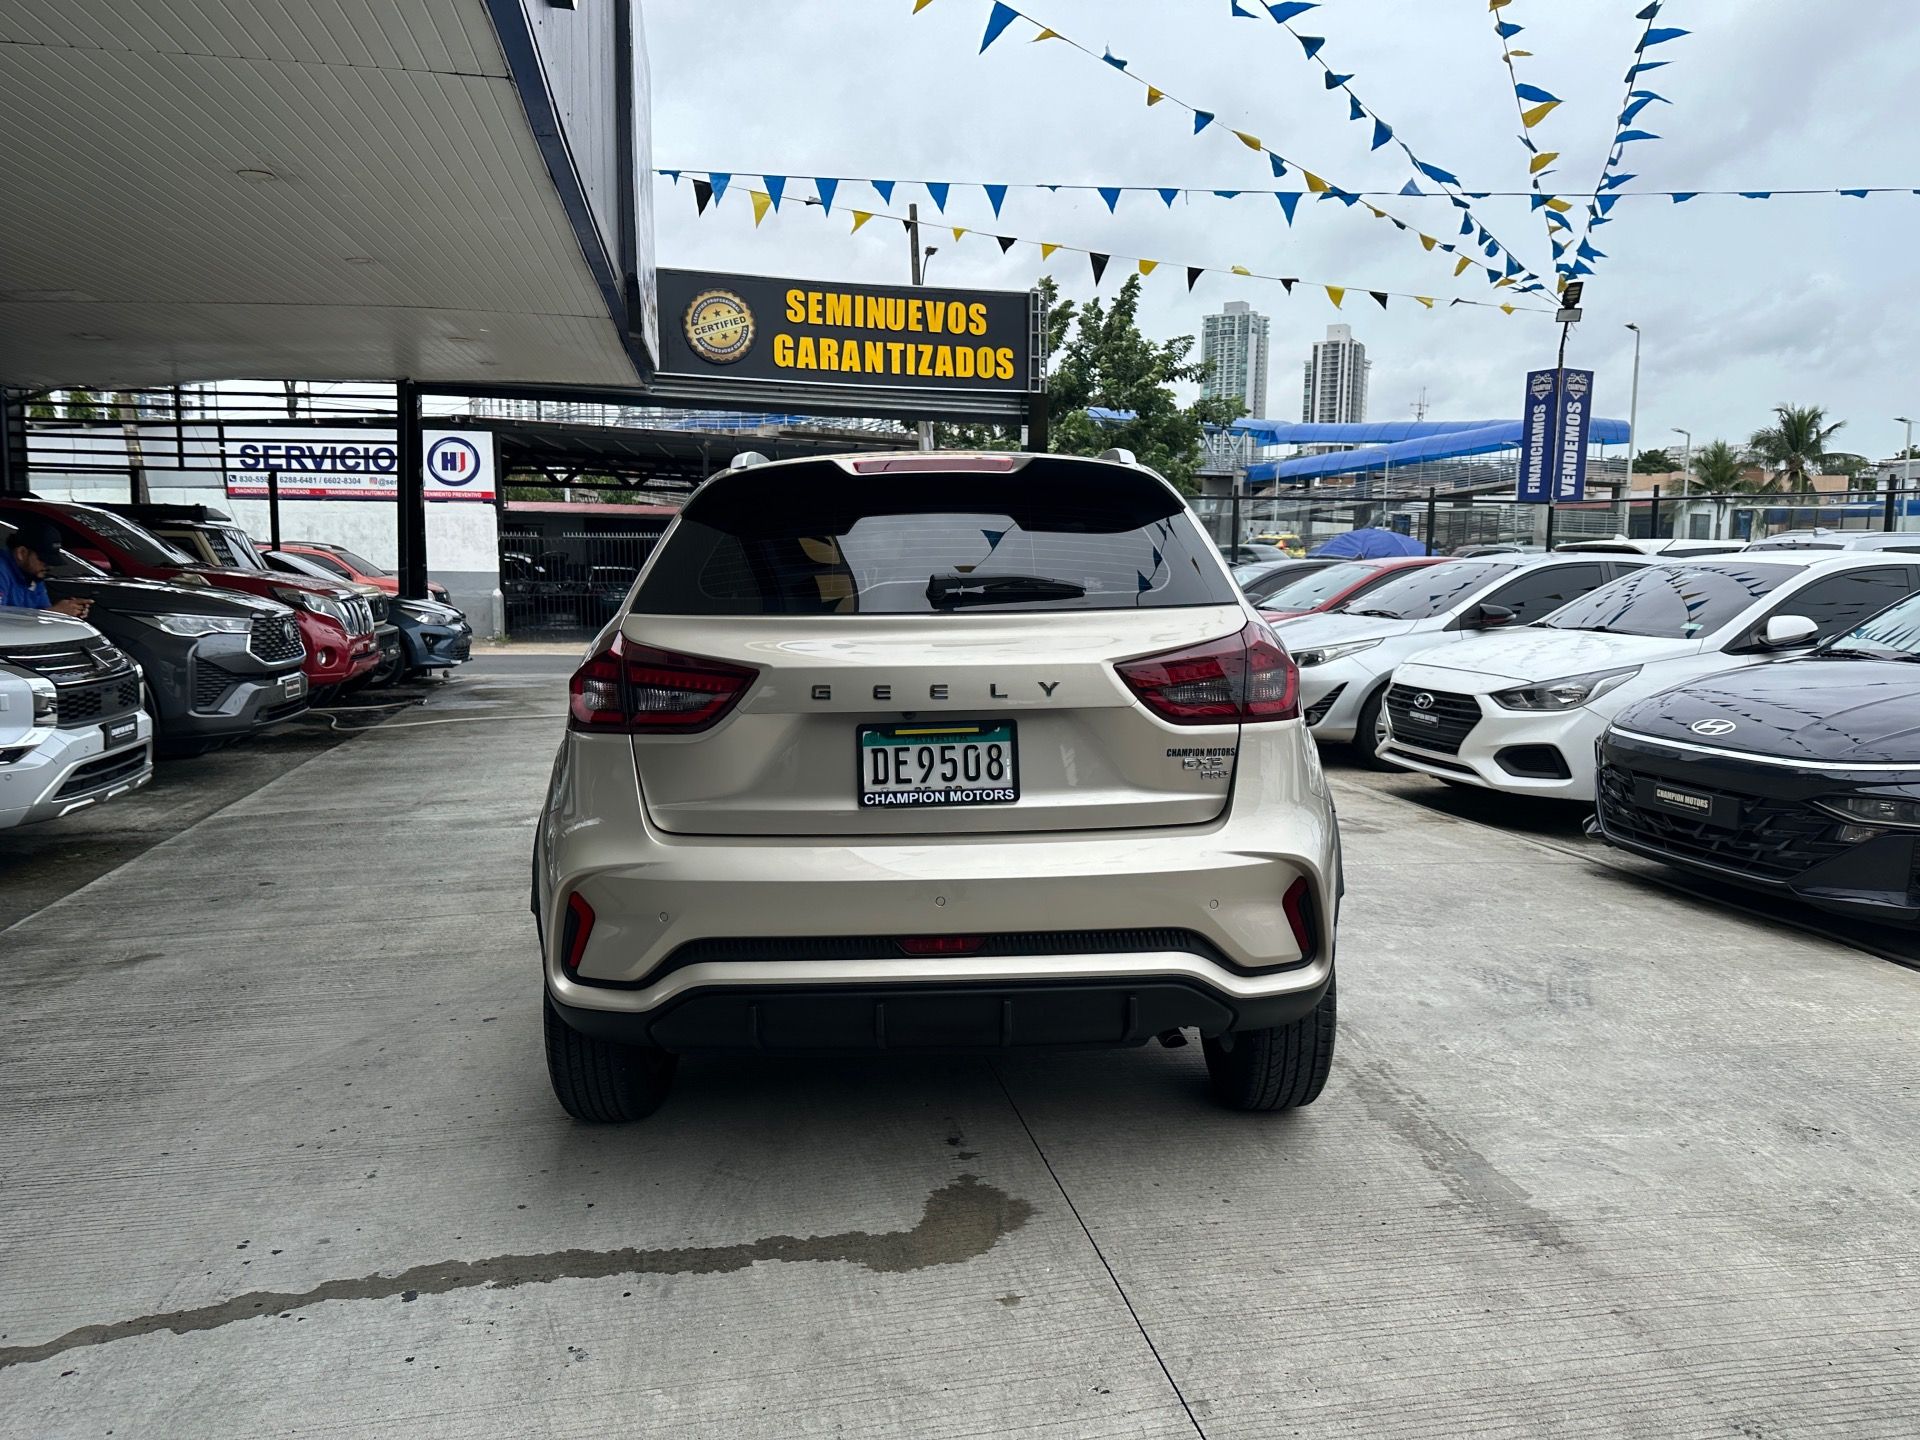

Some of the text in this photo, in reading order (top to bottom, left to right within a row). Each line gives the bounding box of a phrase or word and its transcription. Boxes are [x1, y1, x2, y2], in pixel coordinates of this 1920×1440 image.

[694, 316, 747, 336] CERTIFIED
[785, 288, 987, 337] SEMINUEVOS
[773, 333, 1015, 380] GARANTIZADOS
[239, 444, 397, 471] SERVICIO
[1527, 404, 1546, 494] FINANCIAMOS
[1560, 401, 1582, 497] VENDEMOS
[811, 681, 1060, 700] GEELY
[870, 743, 1004, 785] DE9508
[1166, 747, 1236, 757] CHAMPION MOTORS
[864, 791, 945, 805] CHAMPION
[949, 789, 1015, 802] MOTORS
